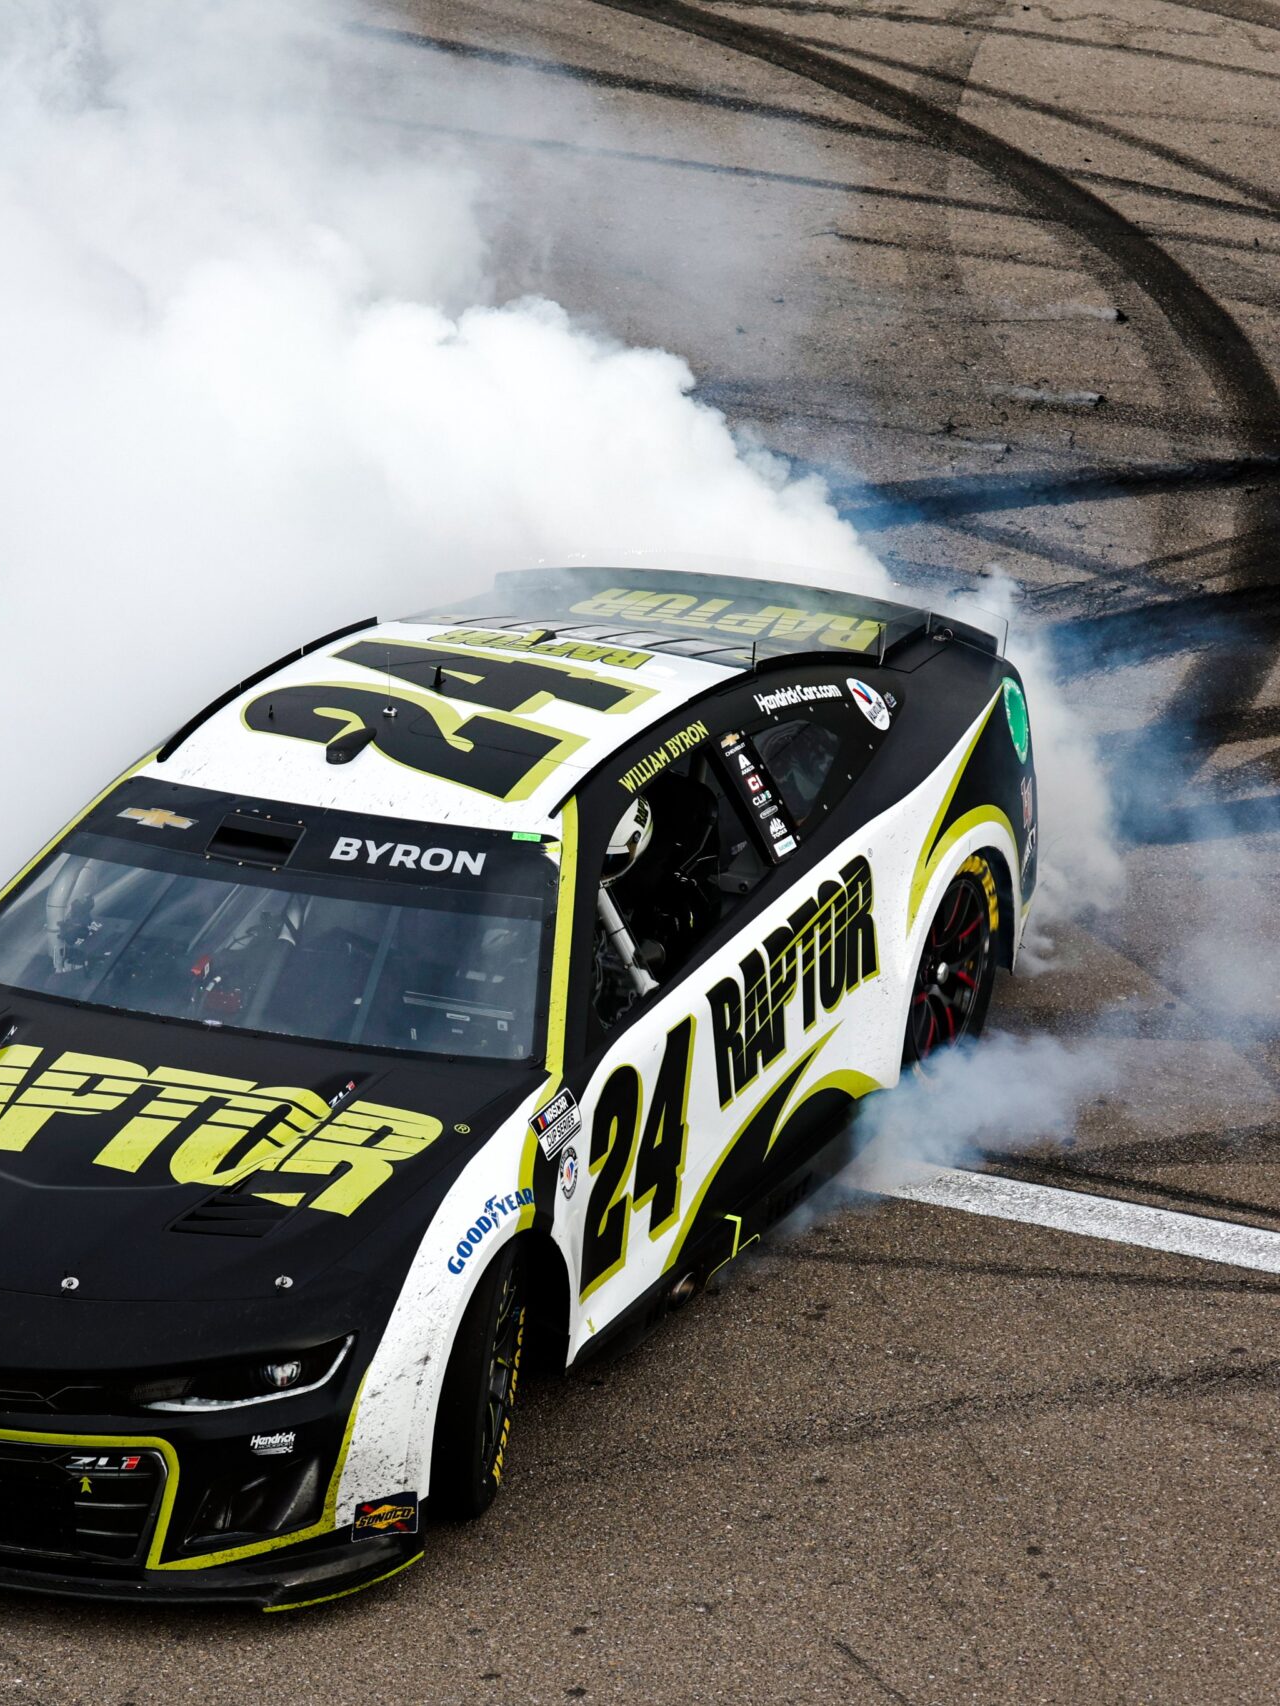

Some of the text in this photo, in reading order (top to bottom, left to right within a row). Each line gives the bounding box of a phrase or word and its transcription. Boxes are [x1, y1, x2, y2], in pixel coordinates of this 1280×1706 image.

[568, 588, 888, 652] RAPTOR
[427, 629, 654, 669] RAPTOR
[240, 637, 661, 802] 24
[618, 719, 710, 794] WILLIAM BYRON
[329, 836, 487, 877] BYRON
[705, 855, 880, 1112] RAPTOR
[544, 1095, 569, 1124] NASCAR
[545, 1113, 575, 1147] CUP SERIES
[579, 1014, 698, 1305] 24
[250, 1431, 296, 1449] Hendrick
[357, 1506, 415, 1529] SUNOCO
